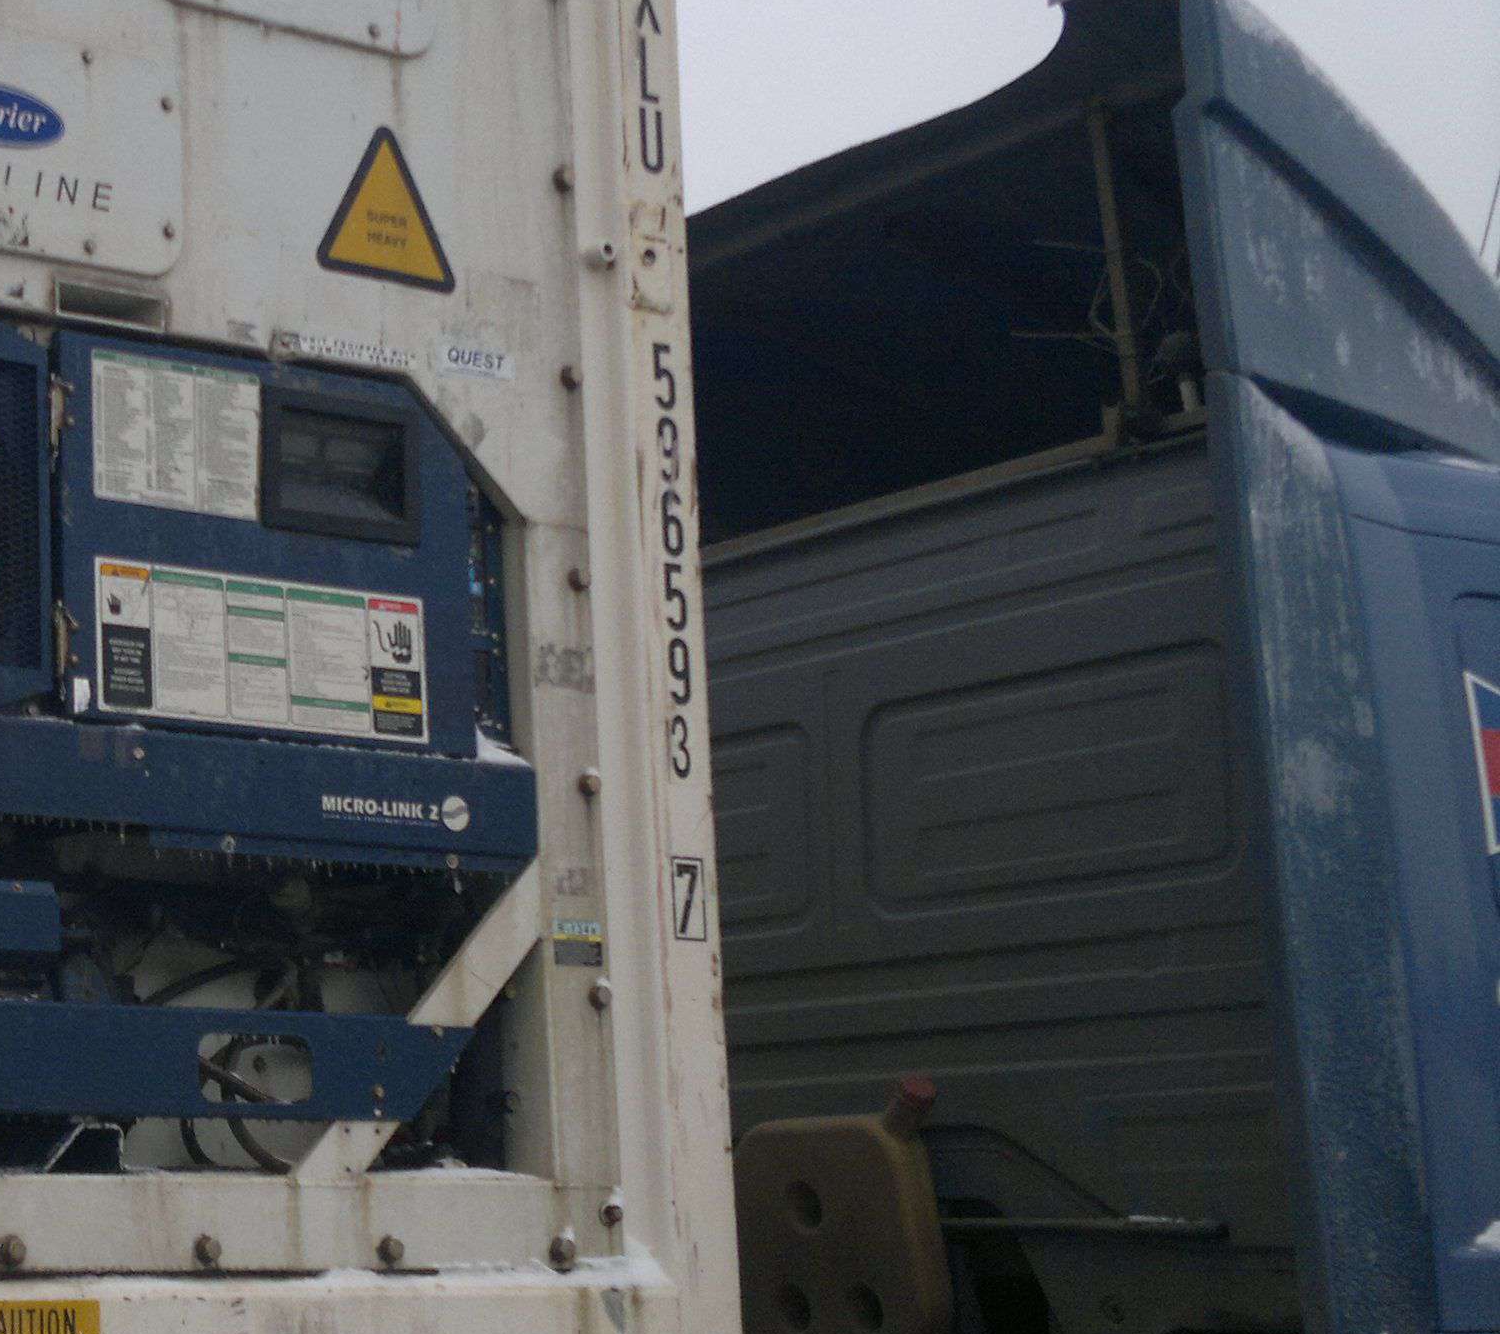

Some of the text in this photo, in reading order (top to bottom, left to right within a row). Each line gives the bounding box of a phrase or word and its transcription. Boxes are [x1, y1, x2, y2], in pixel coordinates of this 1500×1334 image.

[448, 346, 505, 370] QUEST
[652, 343, 690, 779] 596593
[674, 864, 699, 936] 7
[322, 795, 439, 820] MICRO-LINK 2
